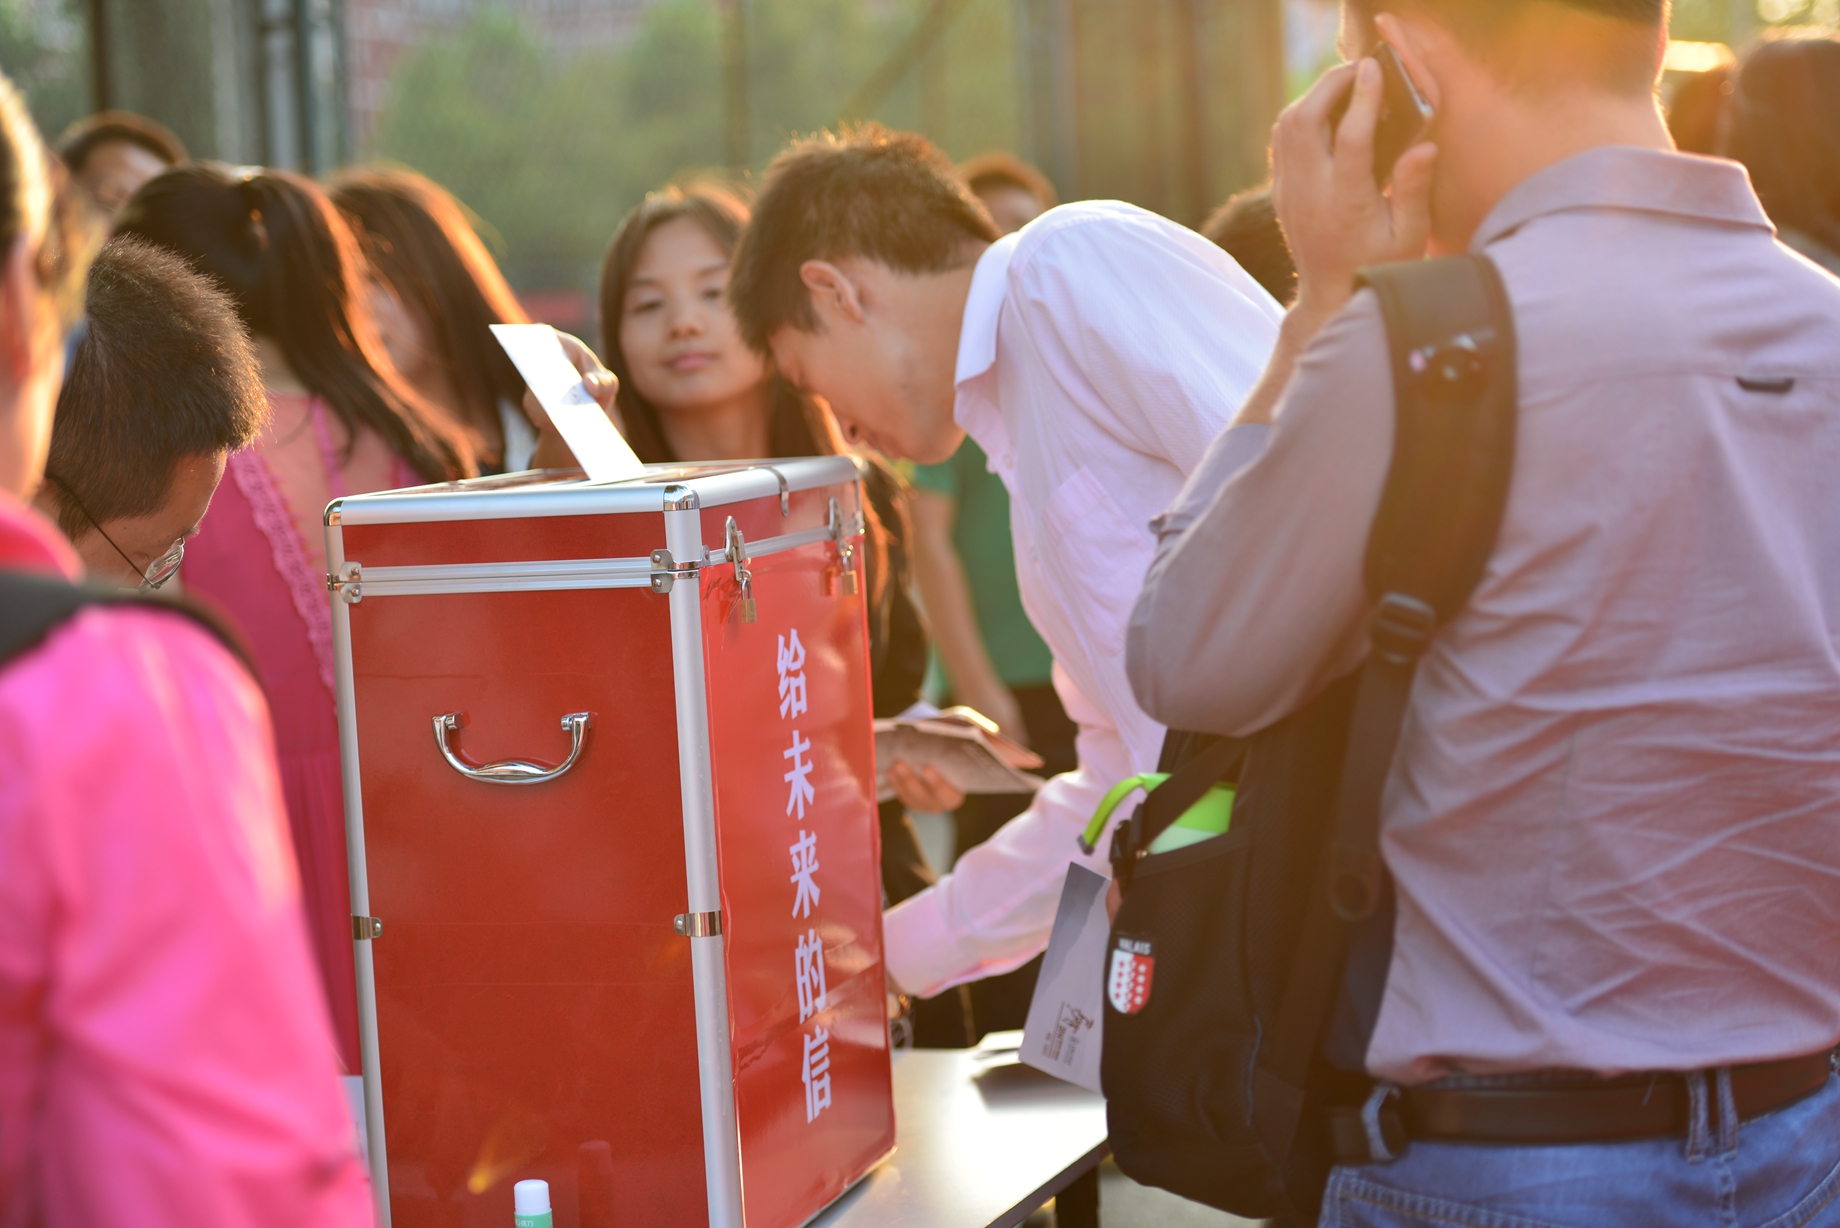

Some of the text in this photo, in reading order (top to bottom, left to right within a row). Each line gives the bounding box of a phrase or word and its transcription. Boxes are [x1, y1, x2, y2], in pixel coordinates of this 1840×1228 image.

[776, 628, 832, 1124] 给未来的信
[1118, 937, 1152, 956] VALAIS
